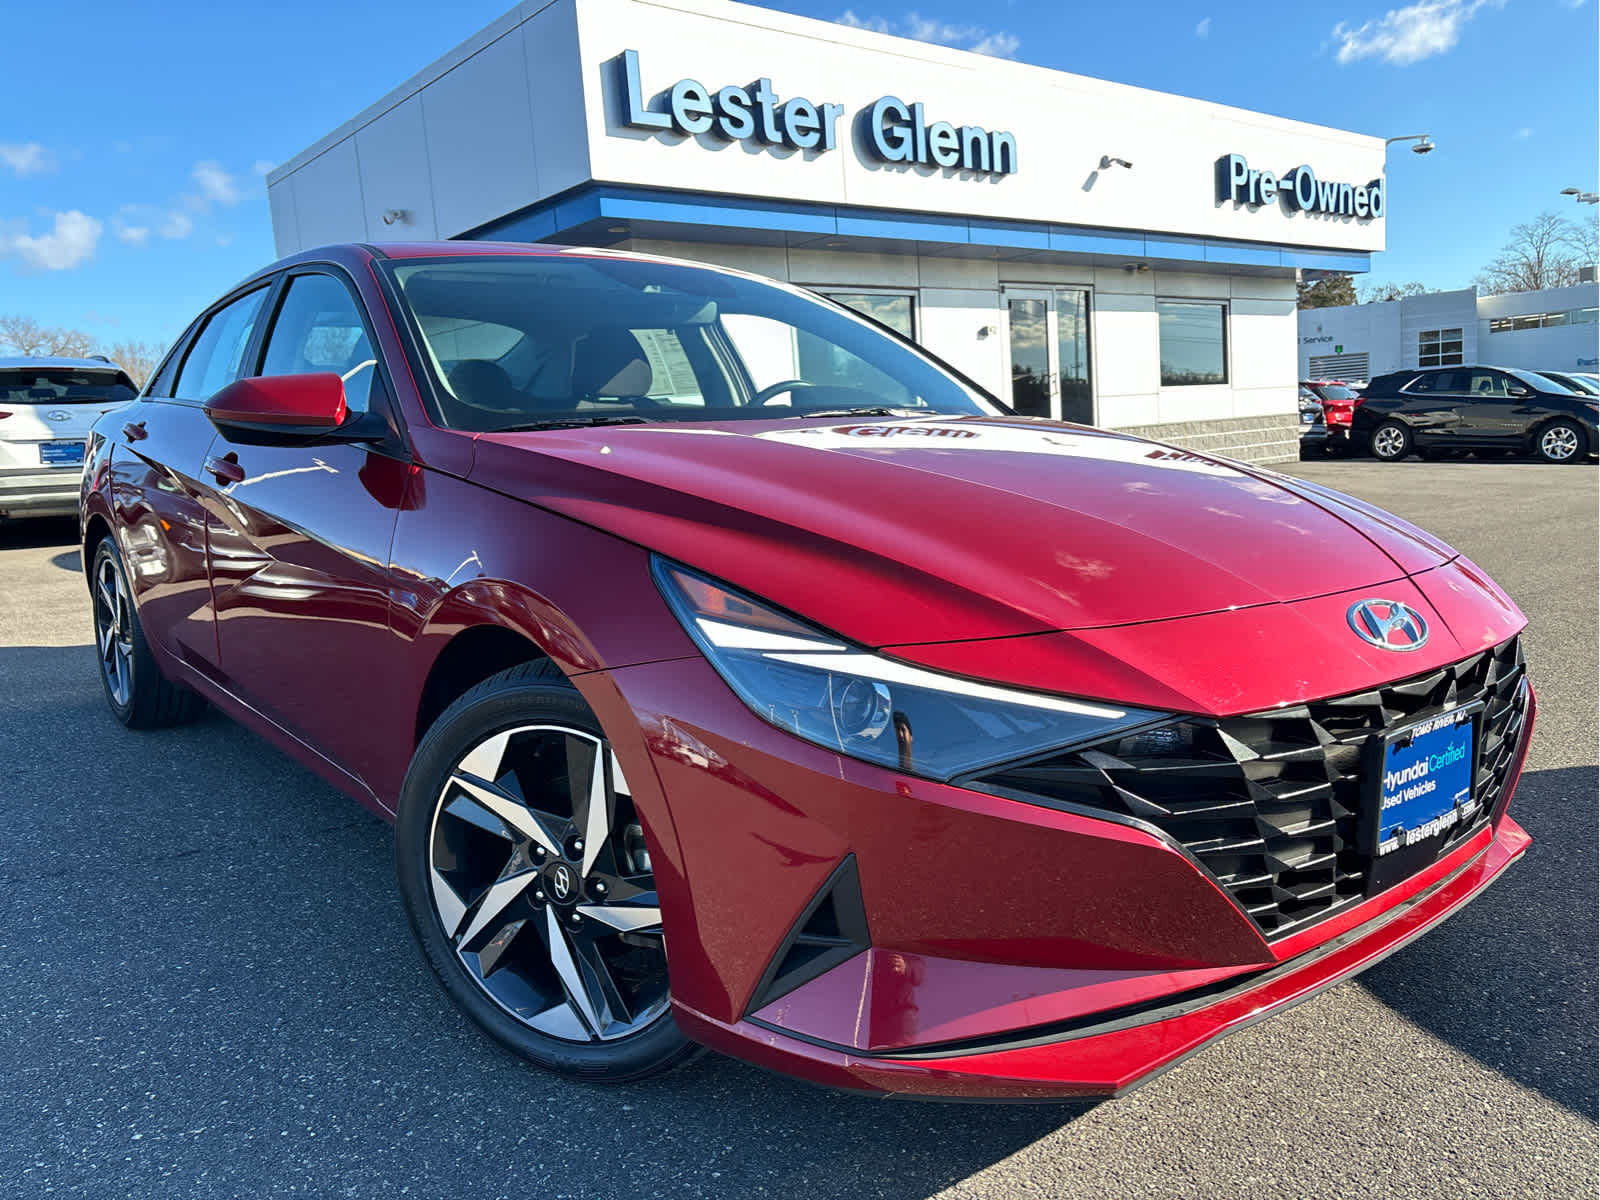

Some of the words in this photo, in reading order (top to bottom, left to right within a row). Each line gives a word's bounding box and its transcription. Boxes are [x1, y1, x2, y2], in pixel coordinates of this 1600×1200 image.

[618, 49, 844, 151] Lester
[868, 95, 1018, 174] Glenn
[1228, 153, 1384, 218] Pre-Owned
[1302, 335, 1334, 345] Service
[1429, 741, 1466, 772] Certified
[1402, 780, 1437, 802] Vehicles
